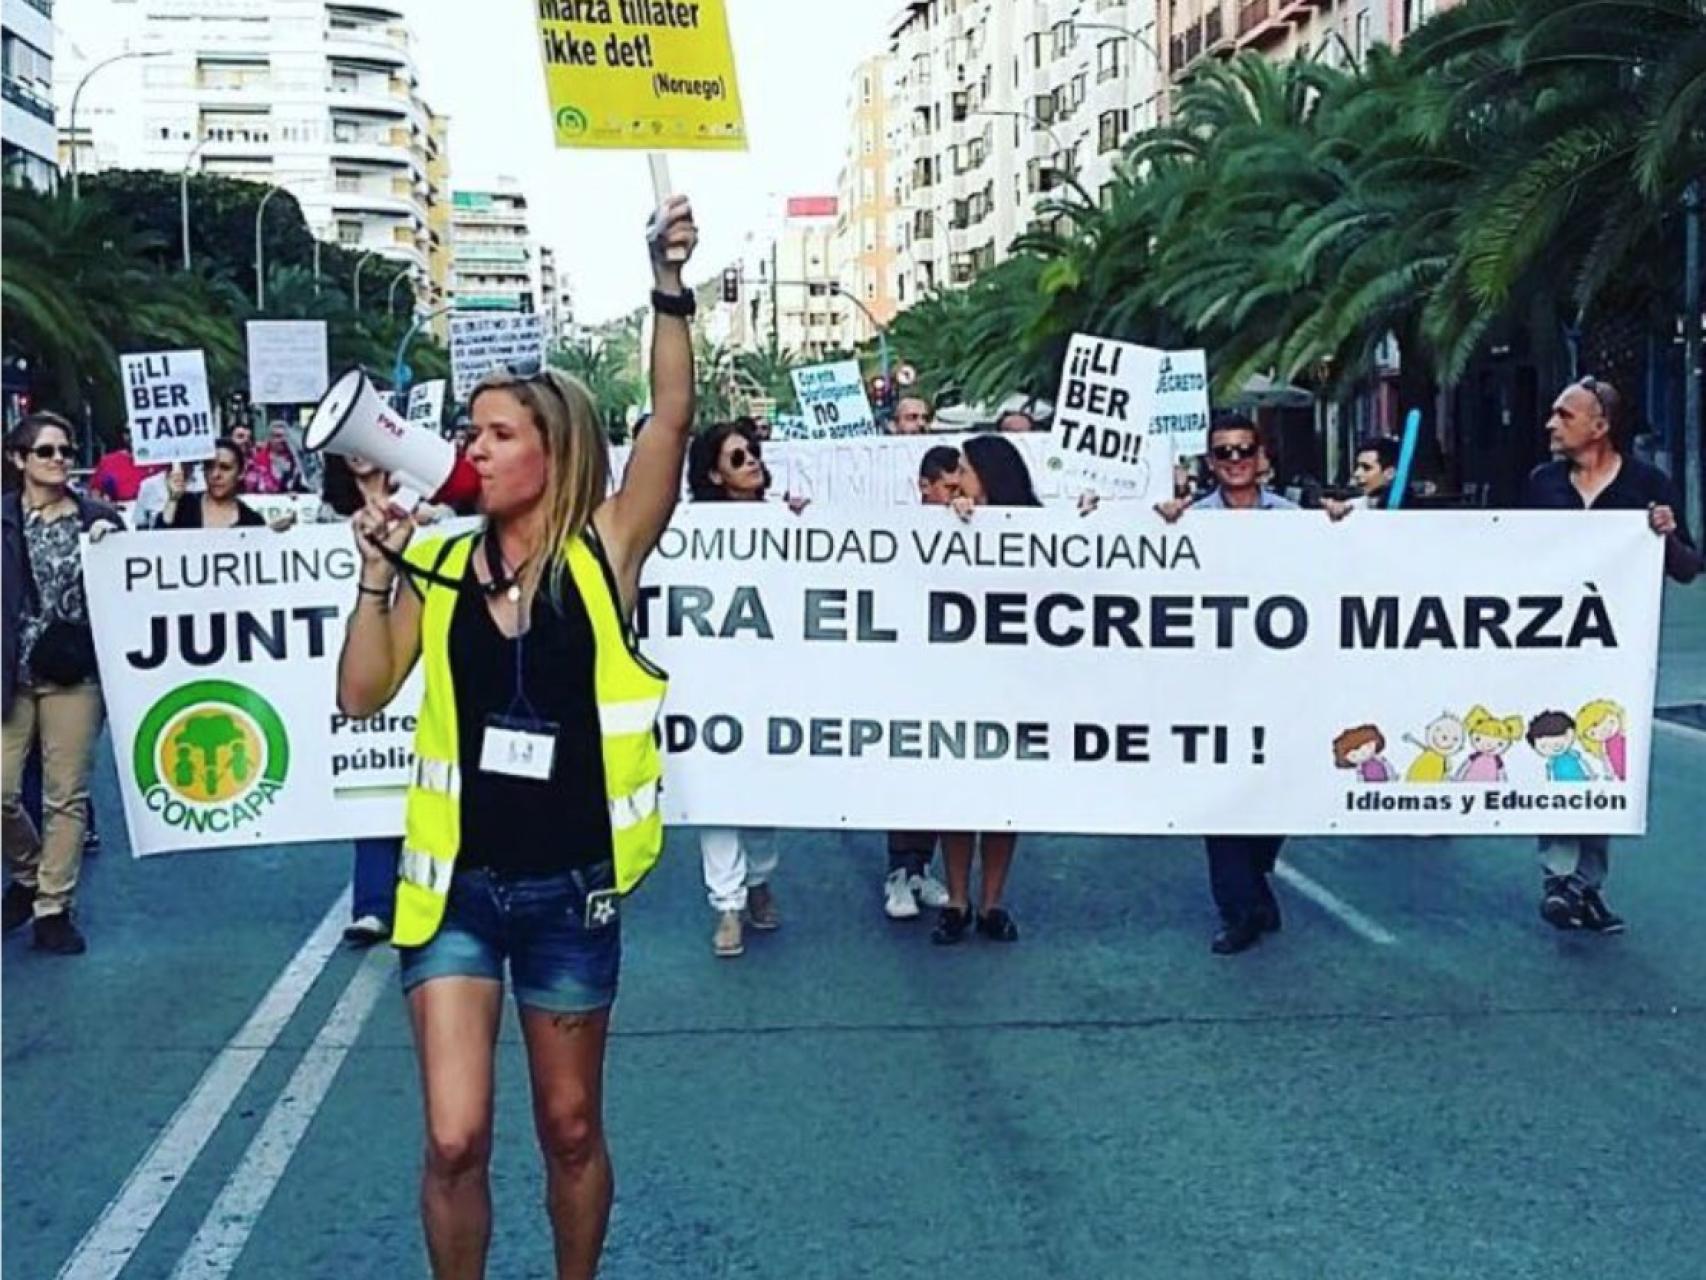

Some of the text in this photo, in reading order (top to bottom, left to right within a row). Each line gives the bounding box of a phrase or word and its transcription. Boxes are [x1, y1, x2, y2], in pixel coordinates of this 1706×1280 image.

[543, 28, 654, 67] ikke det!
[652, 73, 726, 100] (Noruego)
[132, 385, 190, 410] BER
[813, 402, 840, 426] no
[1065, 379, 1130, 420] BER
[136, 412, 210, 441] TAD!!
[1060, 419, 1142, 465] TAD!!
[125, 527, 1201, 592] PLURILING OMUNIDAD VALENCIANA
[126, 581, 1619, 670] JUNT TRA EL DECRETO MARZÀ
[329, 713, 417, 735] Padre
[654, 714, 744, 755] DO
[767, 716, 1050, 761] DEPENDE
[1073, 723, 1150, 762] DE
[1171, 725, 1228, 764] TI
[145, 779, 285, 834] CONCAPA
[1346, 790, 1627, 814] Idiomas y Educación
